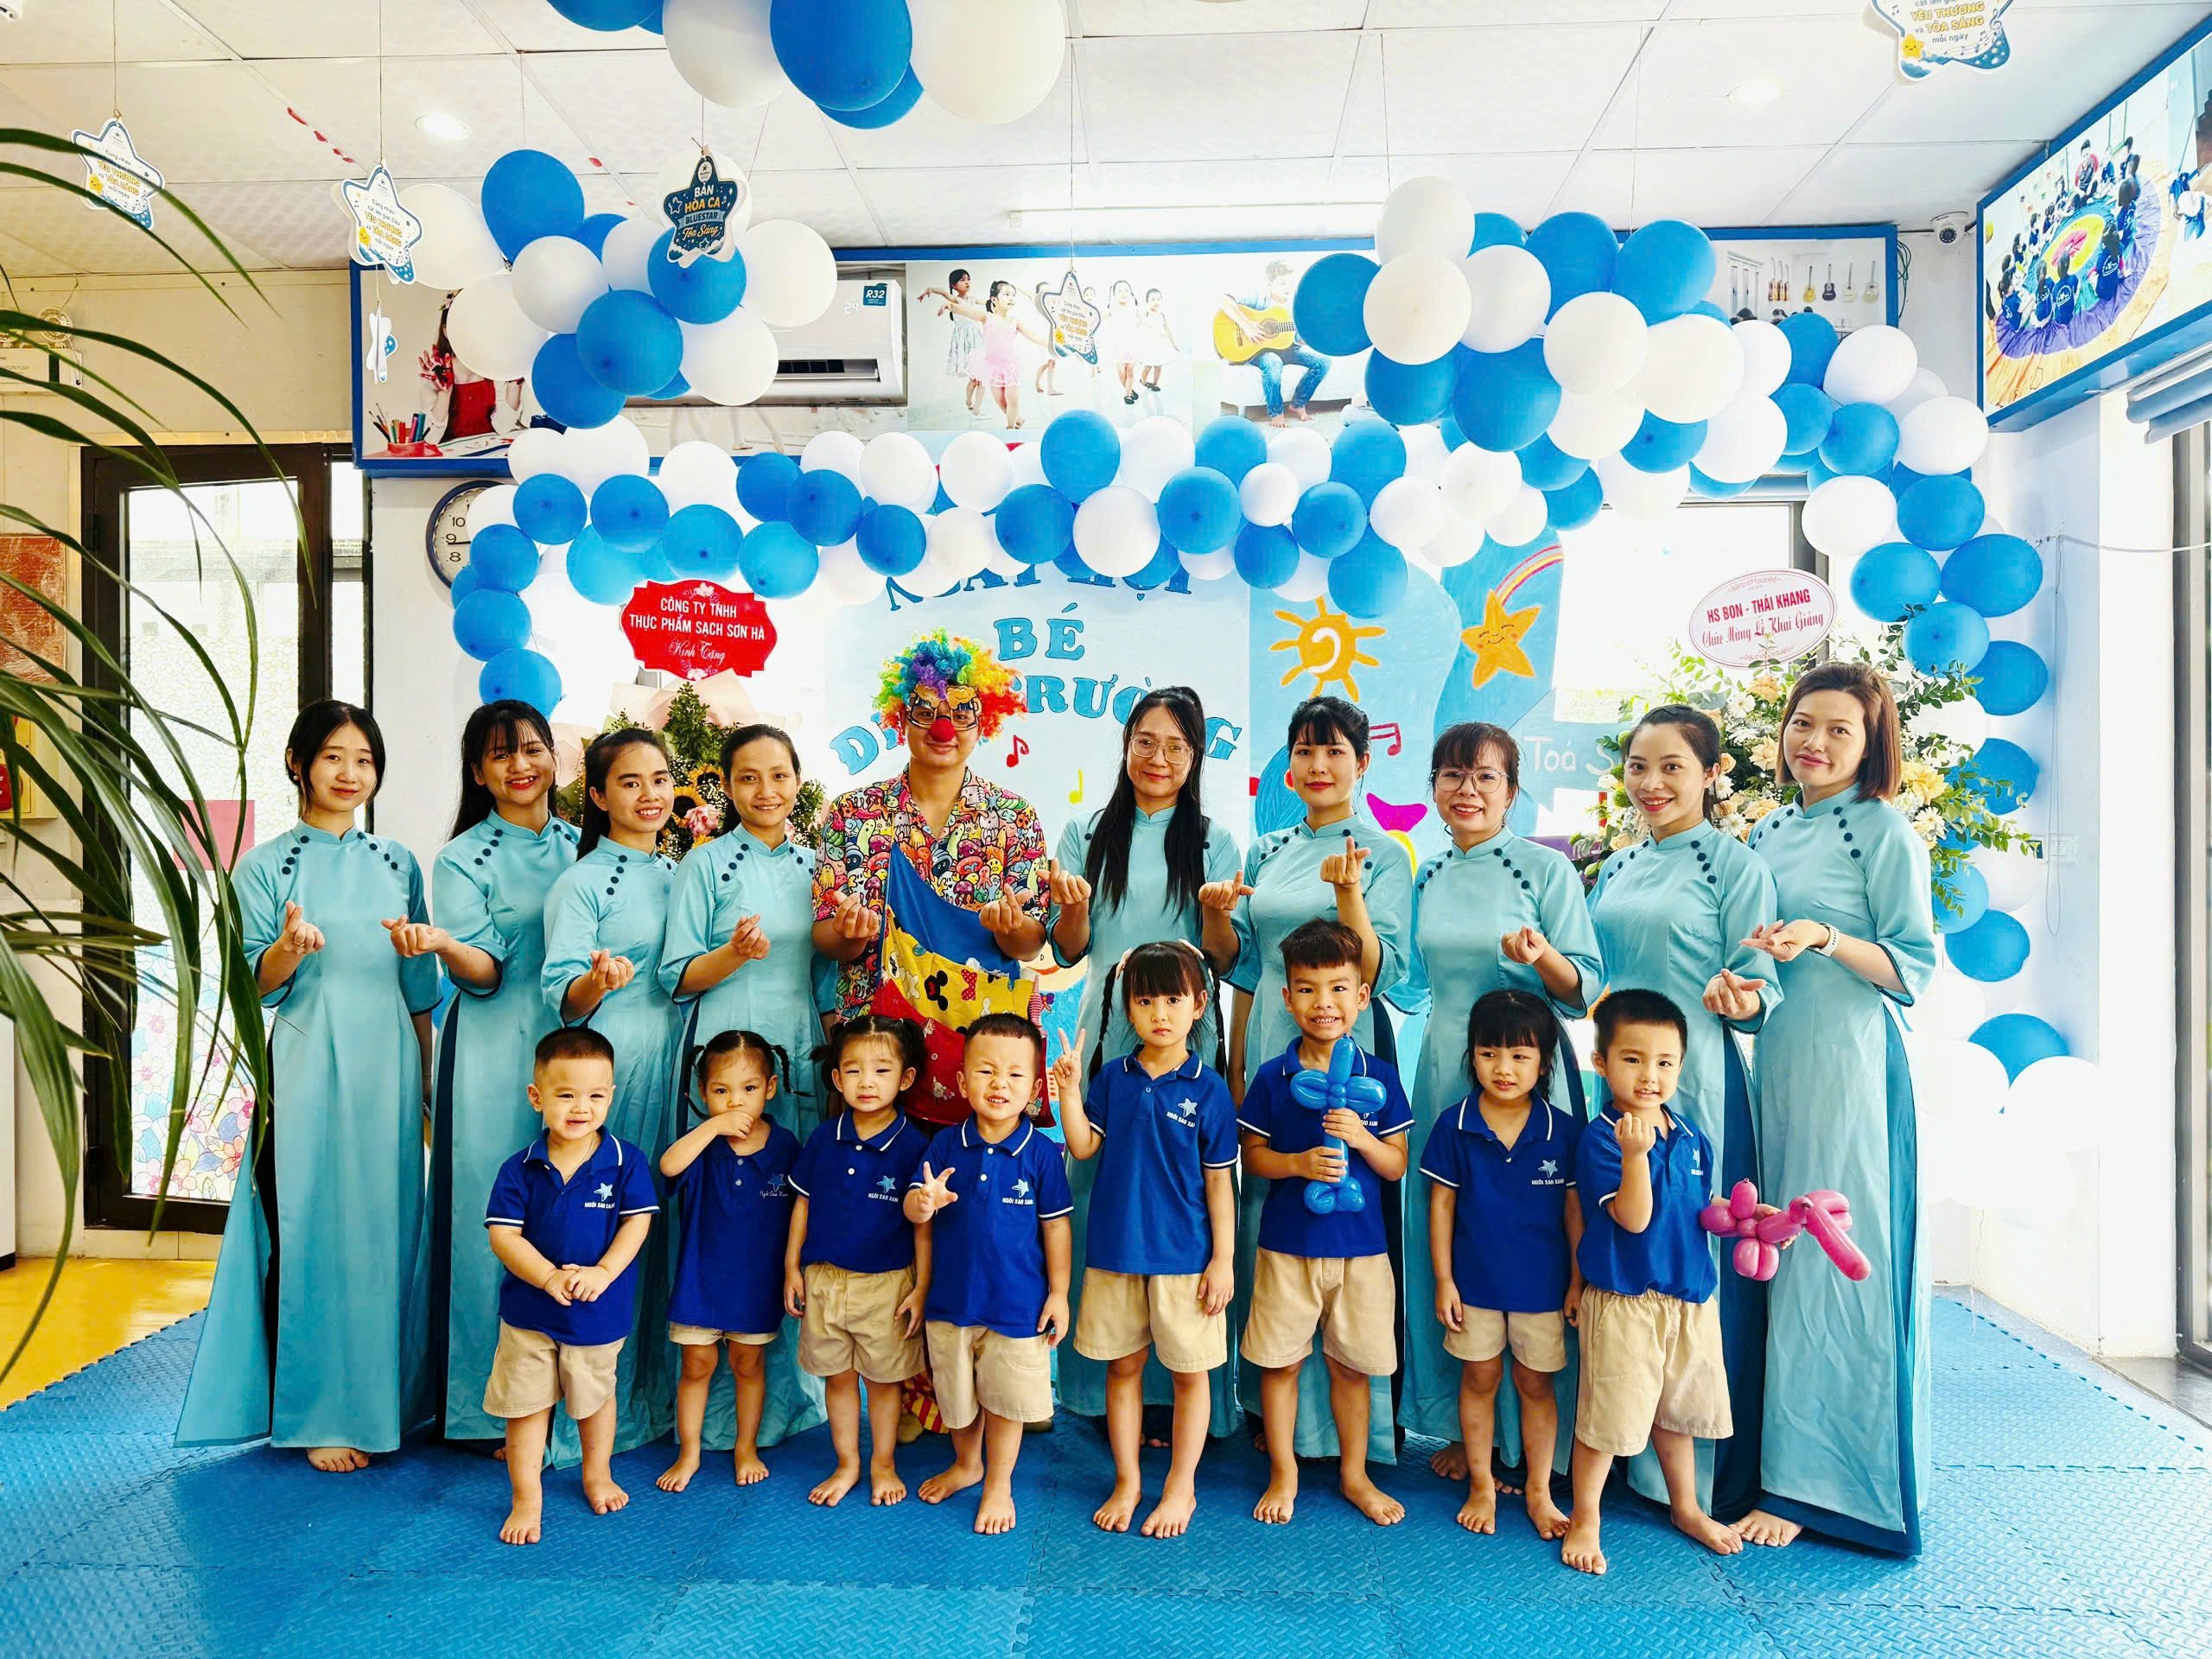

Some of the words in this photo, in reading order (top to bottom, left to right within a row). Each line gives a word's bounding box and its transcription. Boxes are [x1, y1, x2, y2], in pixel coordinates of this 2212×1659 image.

[1910, 9, 1932, 22] YÊU
[707, 196, 721, 208] CA
[685, 212, 718, 225] BLUESTAR
[865, 289, 886, 299] R32
[452, 517, 466, 527] 10
[446, 533, 457, 544] 9
[449, 551, 461, 562] 8
[660, 595, 690, 613] CÔNG
[693, 601, 706, 615] TY
[710, 602, 737, 618] TNHH
[1723, 603, 1743, 620] BON
[1776, 588, 1811, 608] KHANG
[629, 614, 657, 632] THỰC
[661, 613, 691, 633] PHẨM
[696, 621, 723, 638] SẠCH
[727, 624, 748, 639] SƠN
[751, 625, 765, 640] HÀ
[993, 601, 1085, 662] BÉ
[1769, 616, 1792, 635] Khai
